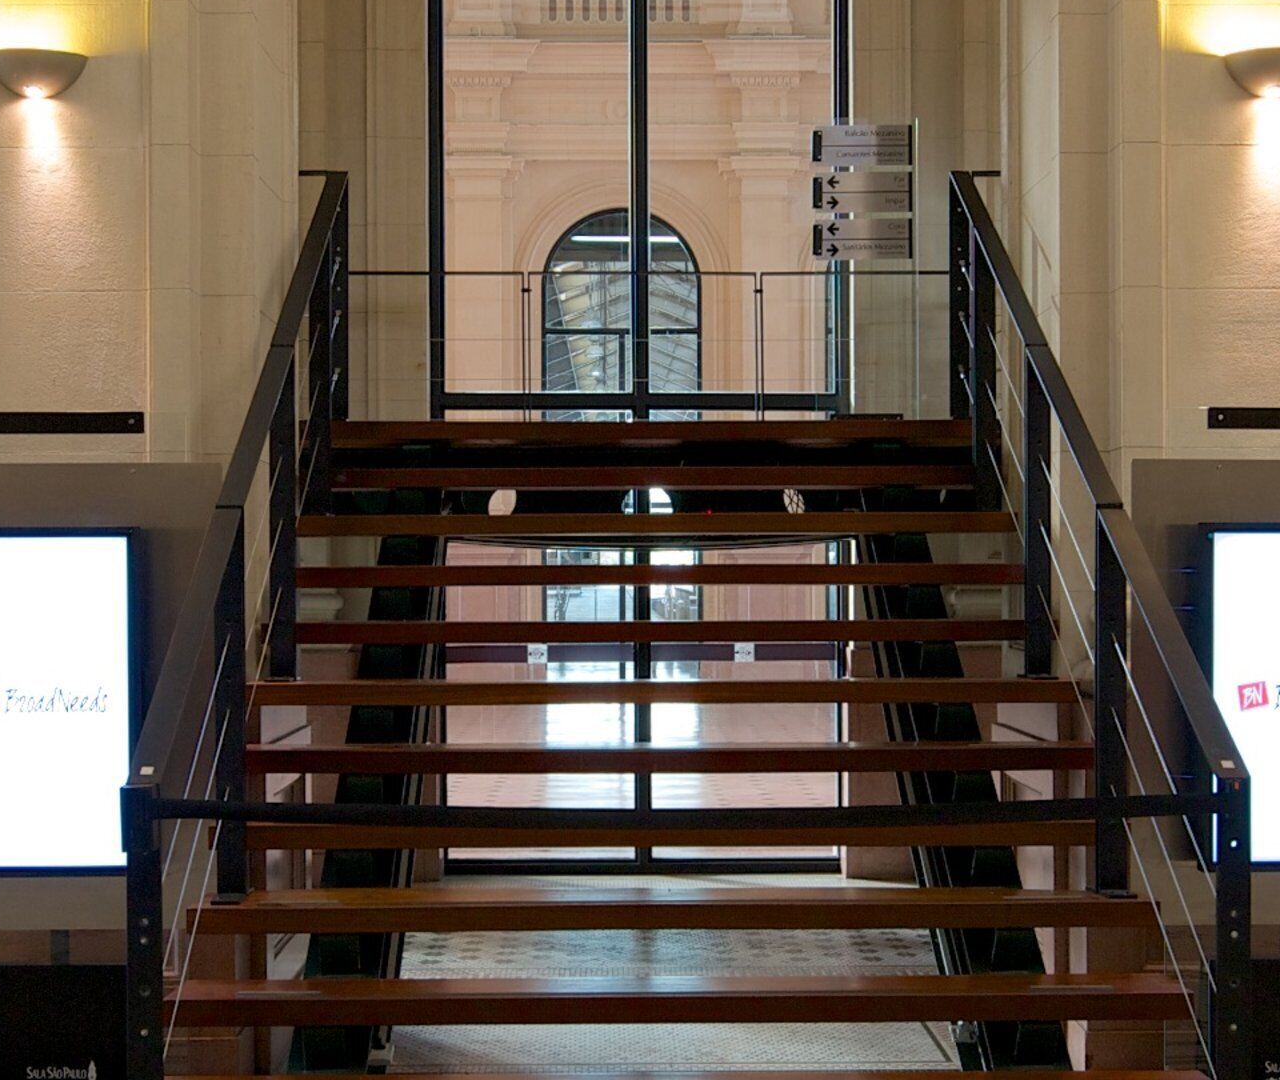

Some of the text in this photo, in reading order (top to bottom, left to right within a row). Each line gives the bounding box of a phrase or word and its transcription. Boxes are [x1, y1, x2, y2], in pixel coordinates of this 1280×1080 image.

[5, 685, 108, 714] BroadNeeds
[1243, 683, 1264, 708] BN
[26, 1066, 87, 1080] SALA SÃO PAULO
